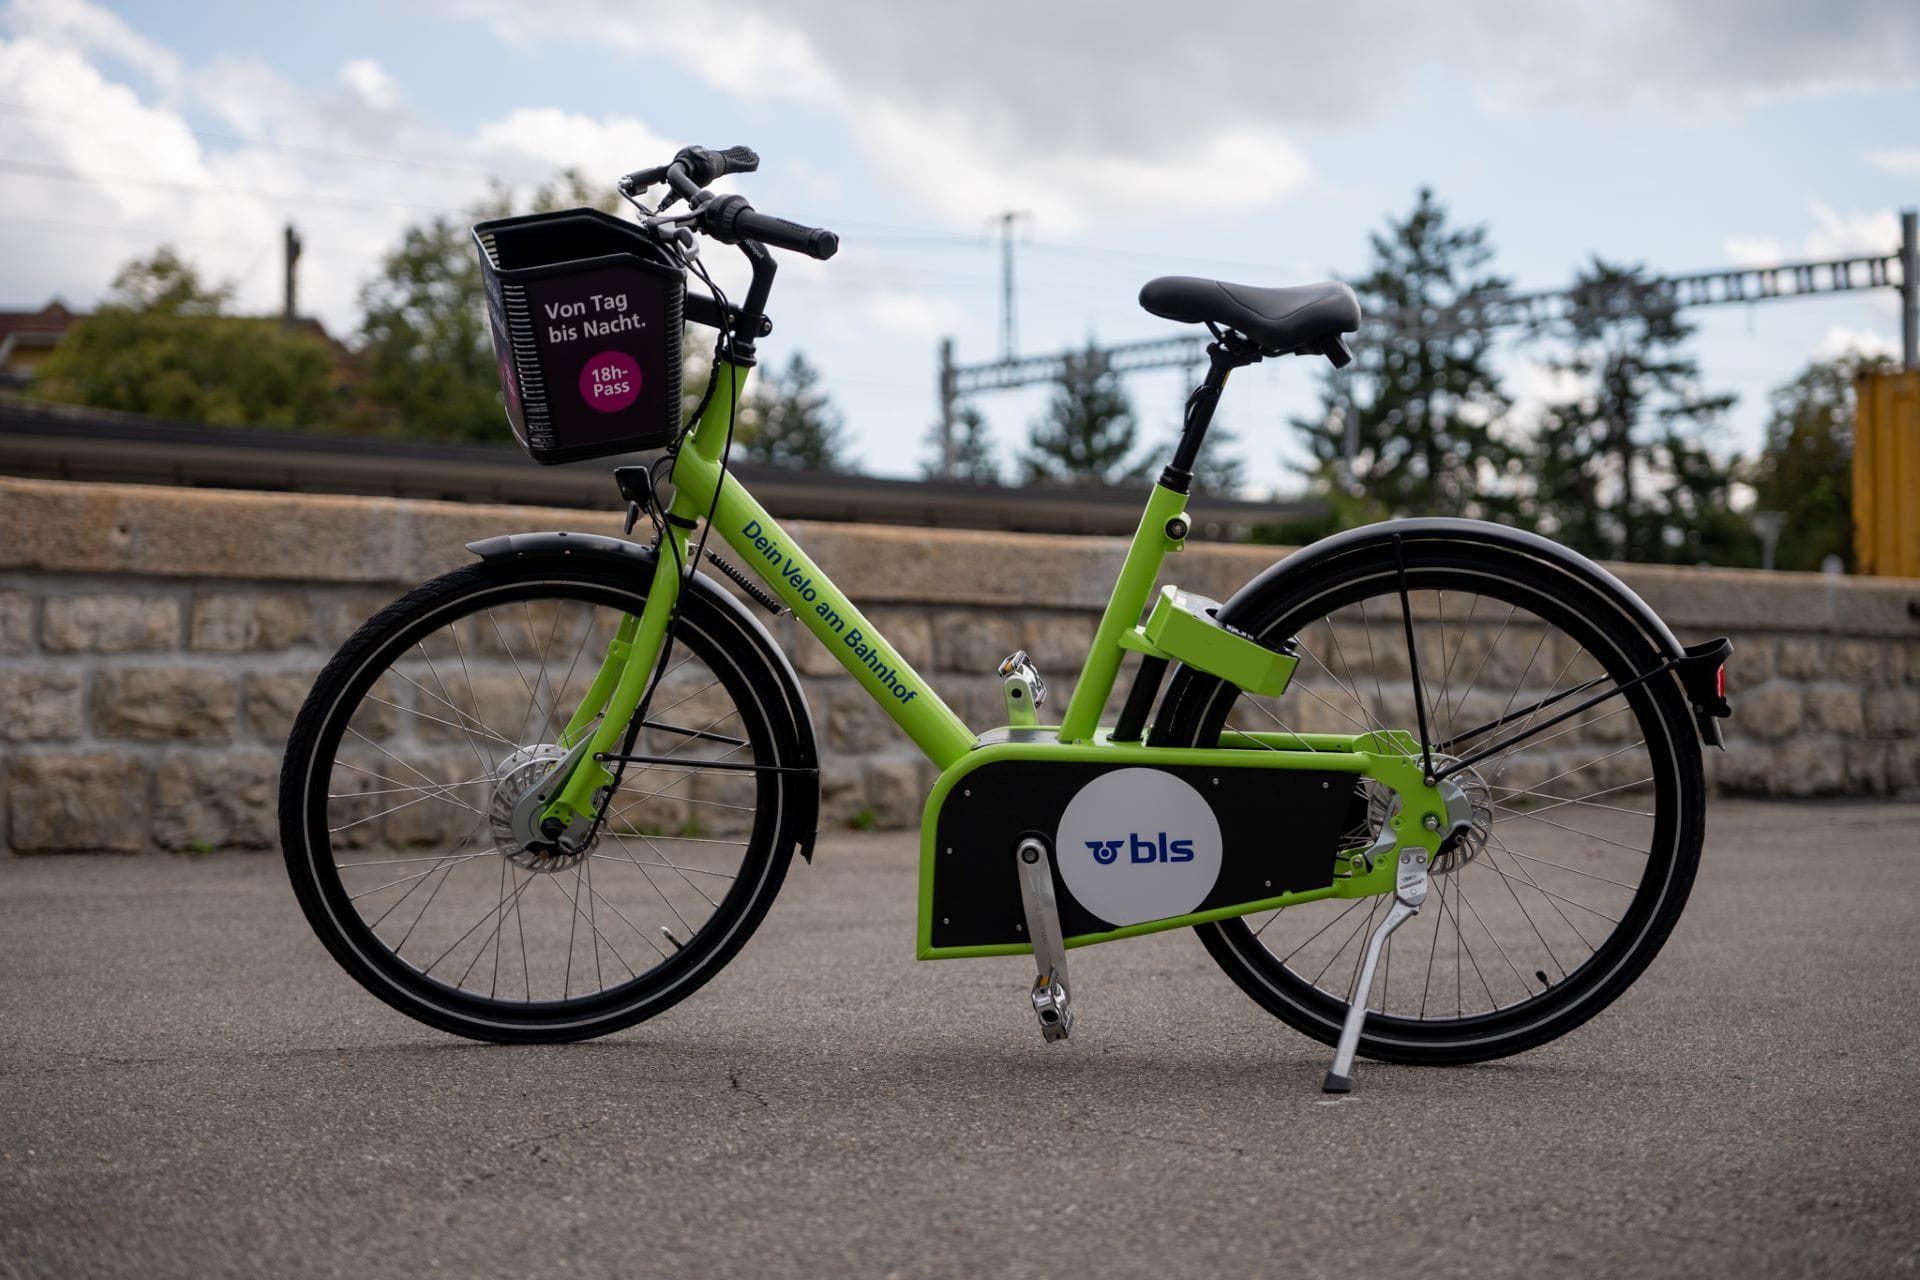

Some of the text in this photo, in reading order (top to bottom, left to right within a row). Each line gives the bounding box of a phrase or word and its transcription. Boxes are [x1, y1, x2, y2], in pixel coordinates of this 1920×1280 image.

[544, 294, 628, 320] Von Tag
[548, 313, 646, 344] bis Nacht.
[591, 364, 628, 383] 18h-
[593, 381, 630, 398] Pass
[742, 520, 919, 705] Dein Velo am Bahnhof
[1129, 832, 1194, 864] bls
